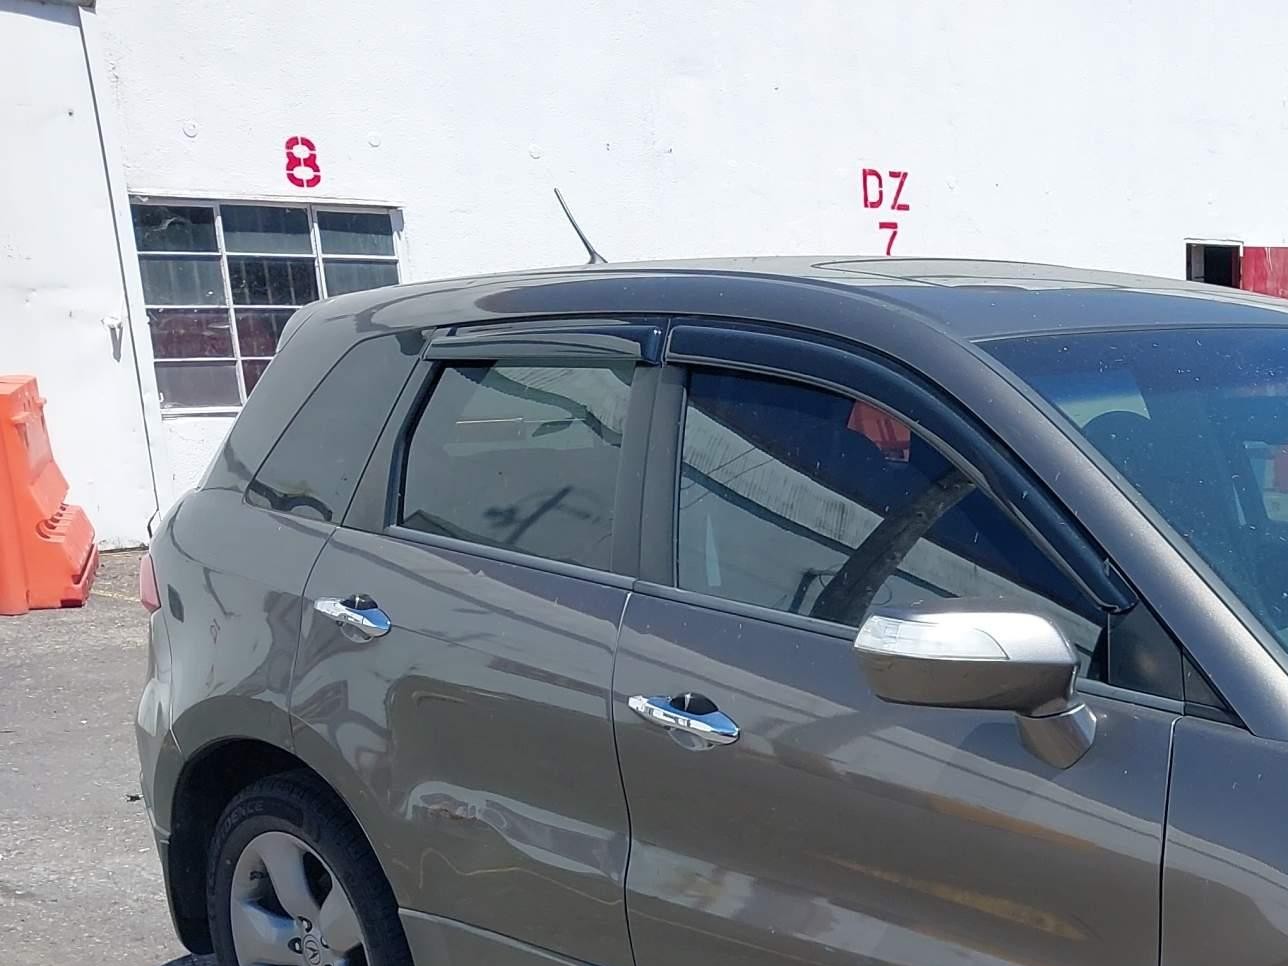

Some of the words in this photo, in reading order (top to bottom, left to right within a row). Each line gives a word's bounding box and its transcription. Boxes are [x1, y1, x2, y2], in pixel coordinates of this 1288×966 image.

[284, 135, 322, 189] 8
[862, 168, 911, 211] DZ
[878, 221, 898, 257] 7
